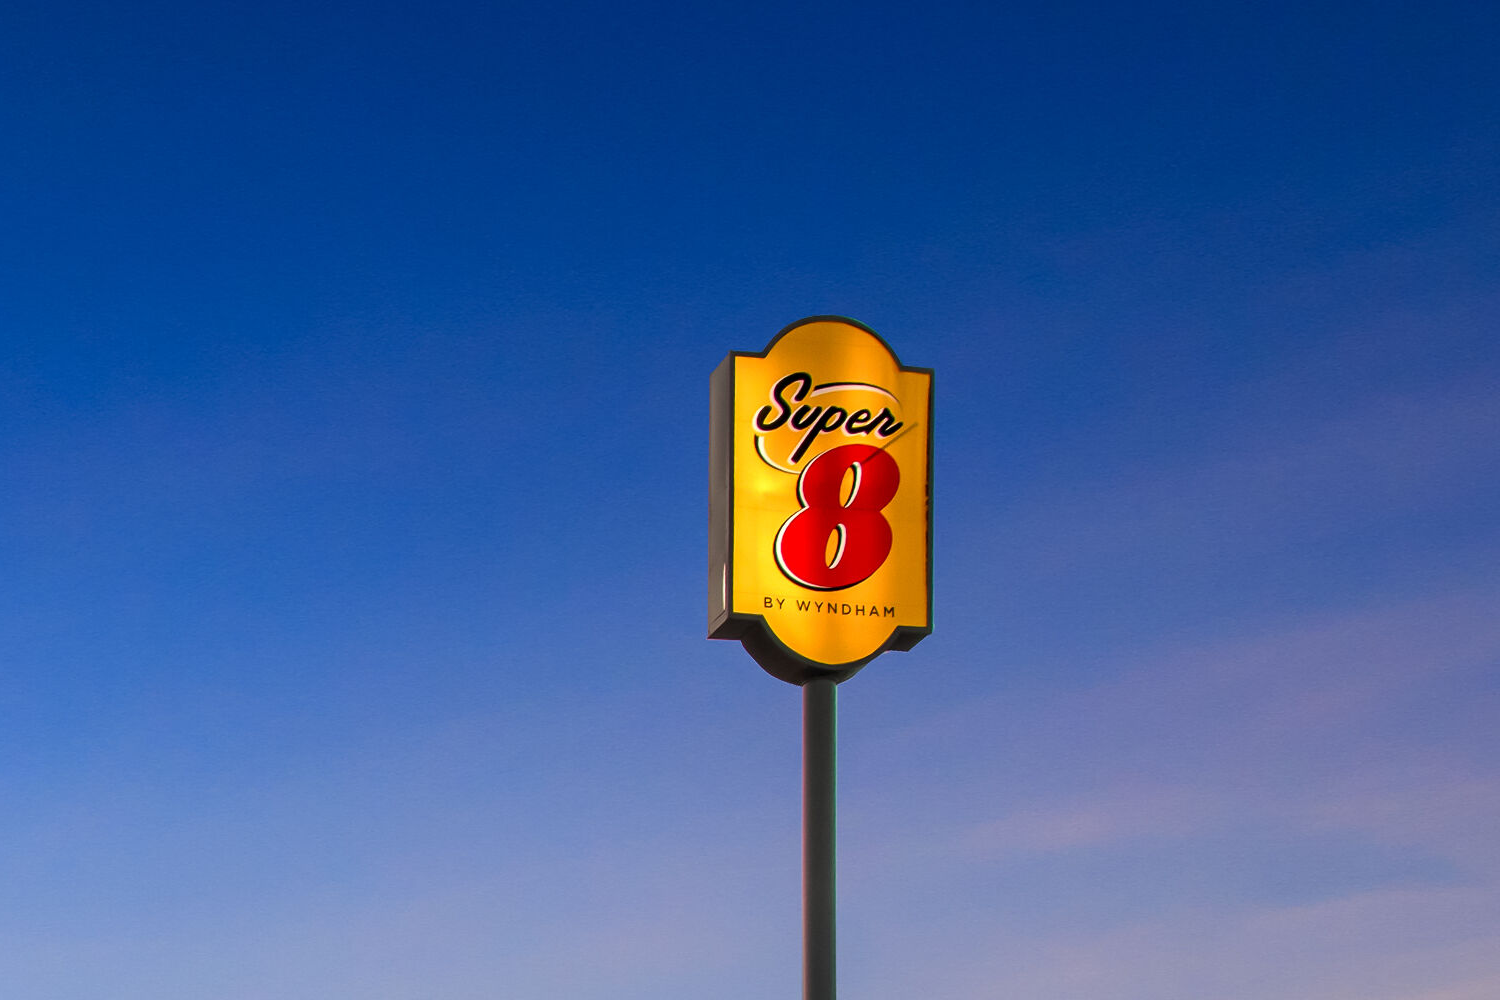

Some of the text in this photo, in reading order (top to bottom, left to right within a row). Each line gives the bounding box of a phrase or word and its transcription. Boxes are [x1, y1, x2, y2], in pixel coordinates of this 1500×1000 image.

[755, 371, 904, 463] Super
[773, 444, 900, 591] 8
[763, 596, 896, 618] BY WYNDHAM
